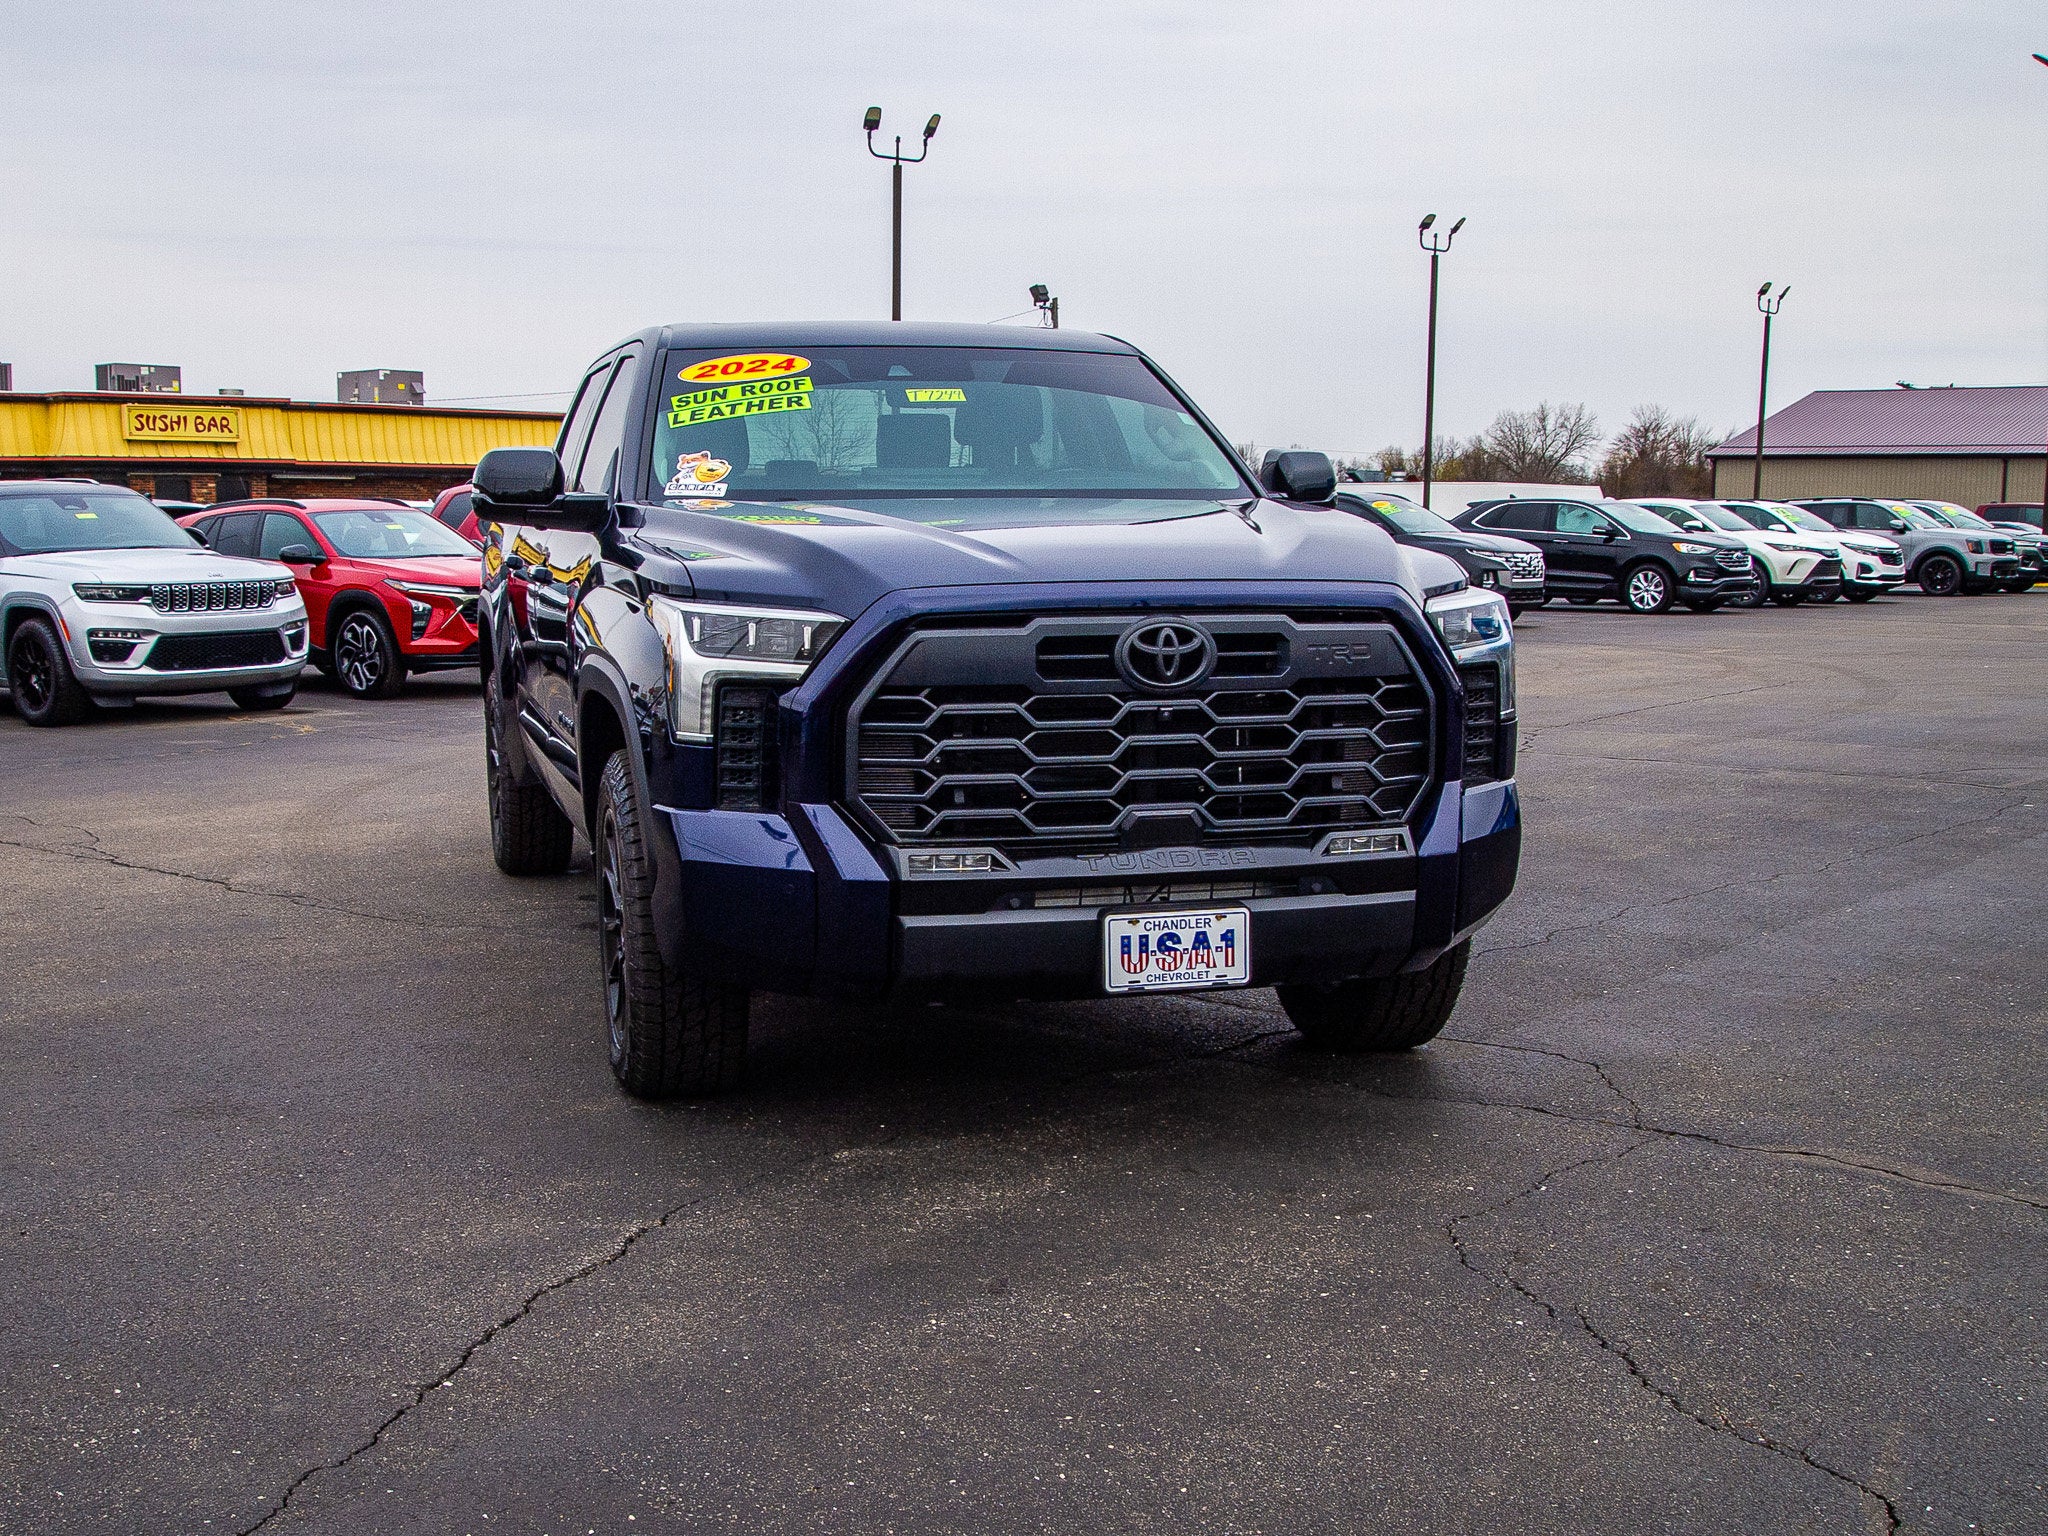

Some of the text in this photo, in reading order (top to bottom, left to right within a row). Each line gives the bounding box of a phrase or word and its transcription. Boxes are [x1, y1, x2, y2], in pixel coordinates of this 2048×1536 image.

[692, 357, 796, 380] 2024
[675, 378, 807, 408] SUN ROOF
[671, 394, 805, 425] LEATHER
[134, 413, 234, 434] SUSHI BAR
[668, 483, 722, 493] CARFAX
[1306, 643, 1371, 666] TRD
[1076, 848, 1257, 872] TUNDRA
[1143, 917, 1213, 932] CHANDLER
[1145, 970, 1211, 984] CHEVROLET
